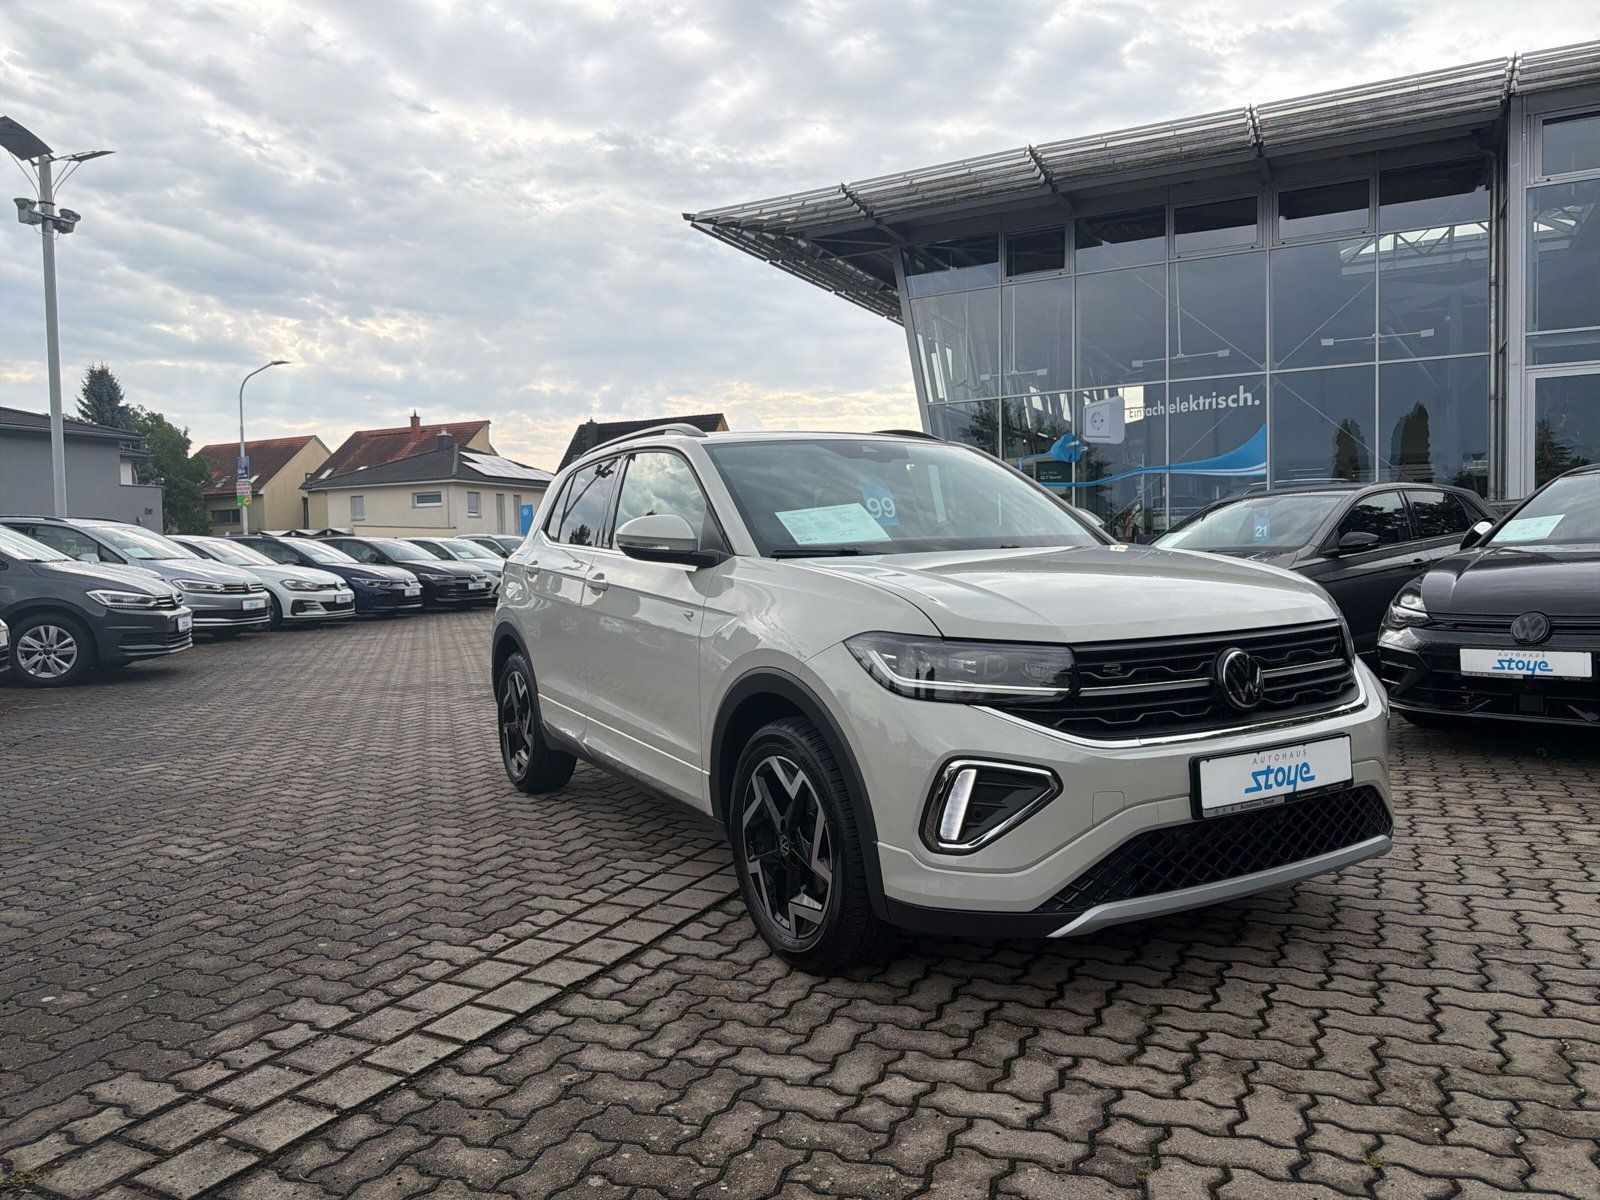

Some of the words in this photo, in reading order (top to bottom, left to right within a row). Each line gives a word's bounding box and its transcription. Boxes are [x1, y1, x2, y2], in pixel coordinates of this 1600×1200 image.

[1169, 385, 1260, 414] elektrisch.
[866, 497, 896, 518] 99
[1255, 525, 1268, 537] 21
[1252, 749, 1308, 765] AUTOHAUS
[1244, 761, 1316, 792] stoye
